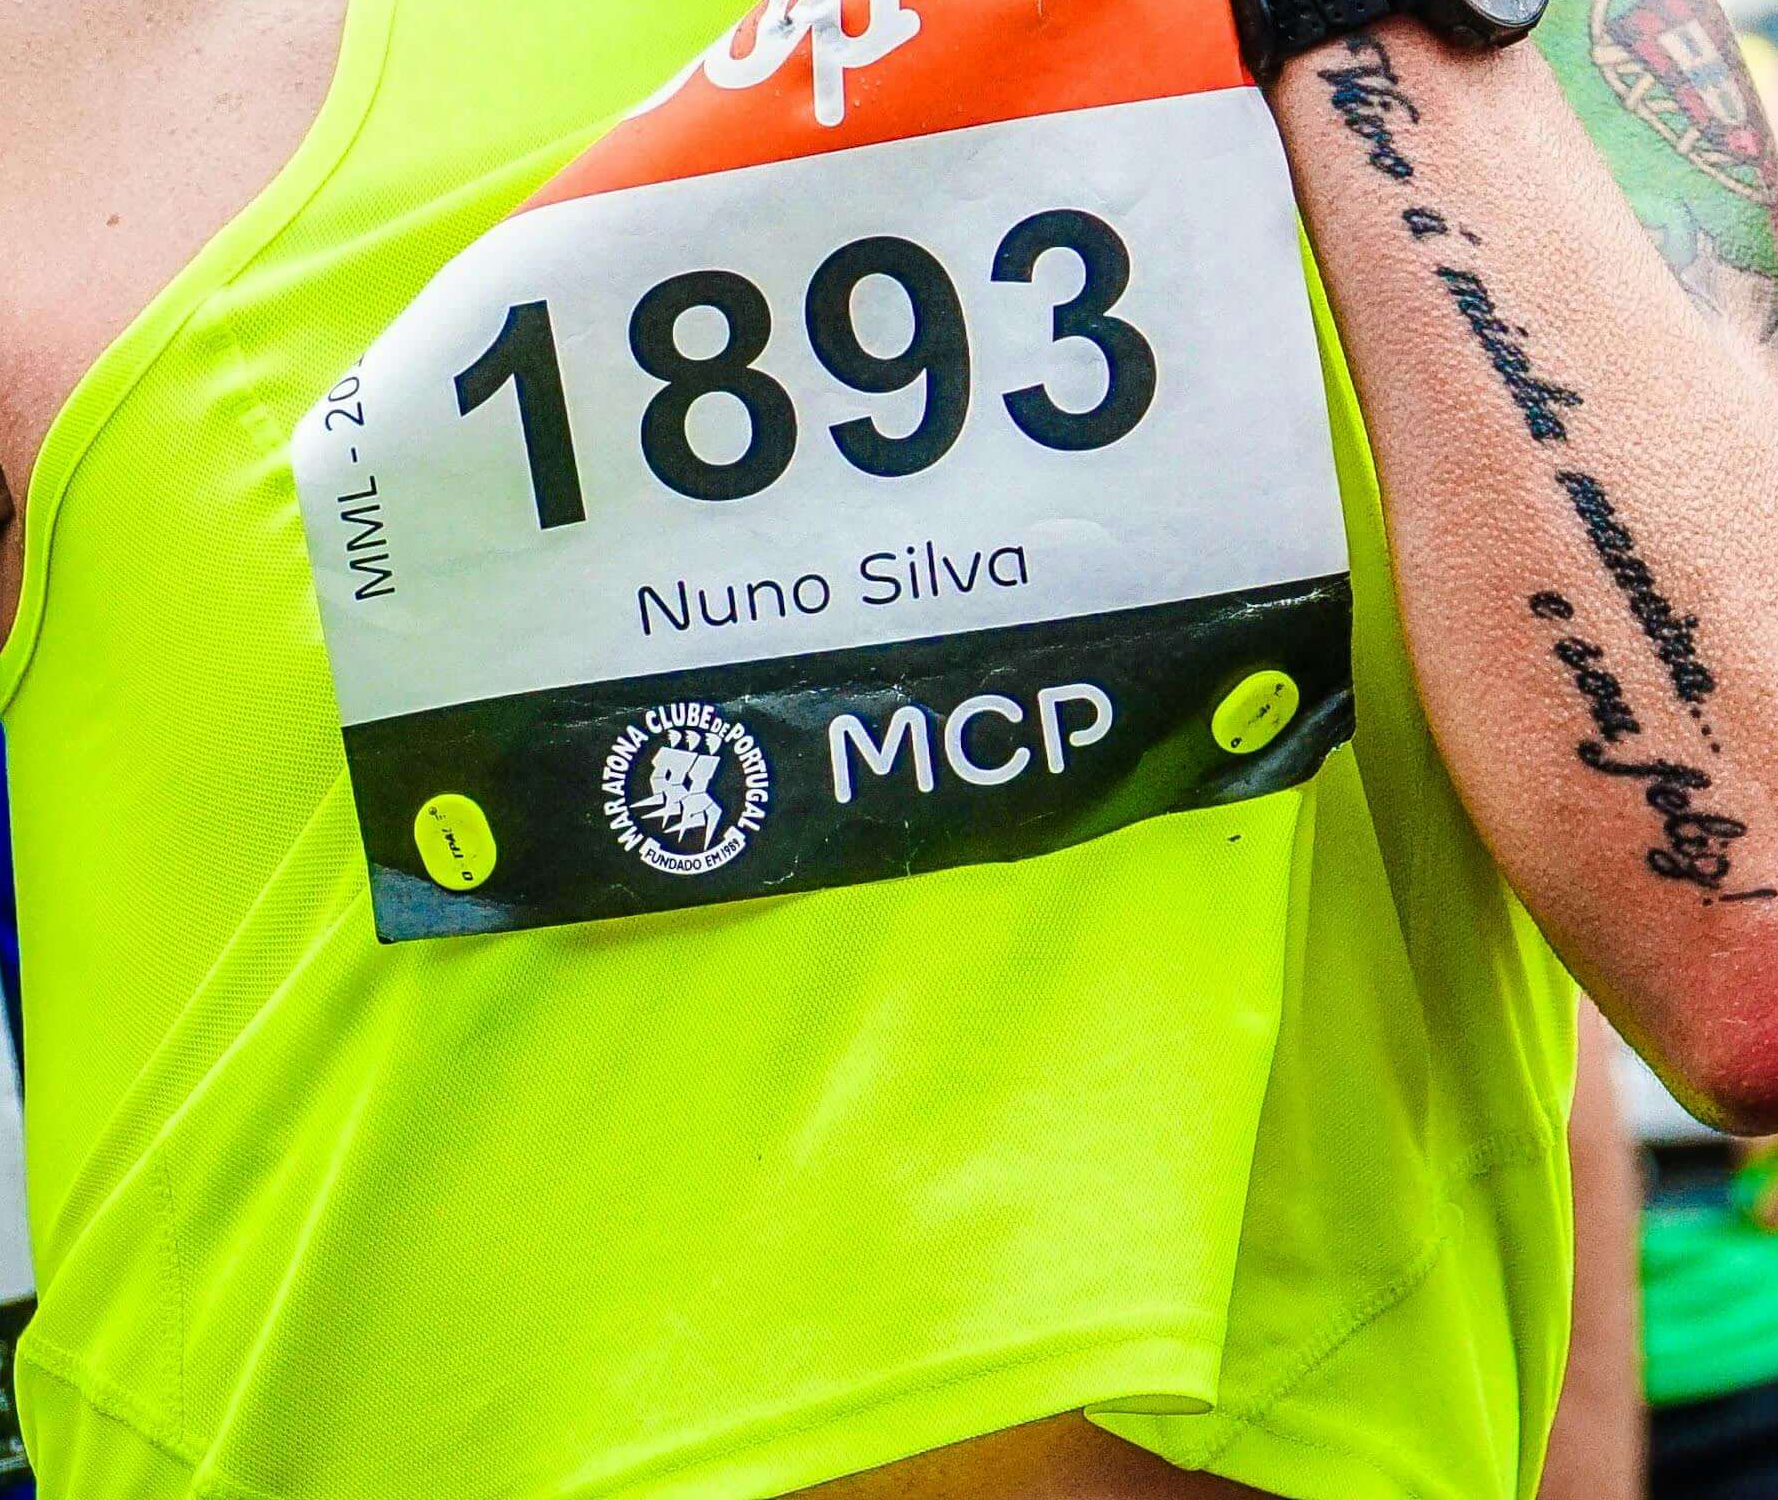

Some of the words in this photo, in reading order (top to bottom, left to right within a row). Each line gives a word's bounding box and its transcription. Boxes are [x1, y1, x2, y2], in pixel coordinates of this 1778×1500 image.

[324, 356, 365, 432] 20
[453, 208, 1158, 531] 1893
[1435, 261, 1585, 446] minha
[336, 474, 396, 601] MML
[636, 570, 831, 637] Nuno
[859, 537, 1030, 608] Silva
[1528, 589, 1575, 623] e
[1553, 633, 1642, 738] sou
[602, 724, 649, 852] MARATONA
[645, 702, 715, 734] CLUBE
[710, 717, 731, 738] DE
[724, 722, 770, 832] PORTUGAL
[828, 681, 1115, 803] MCP
[644, 848, 702, 871] FUNDADO
[705, 852, 722, 868] EM
